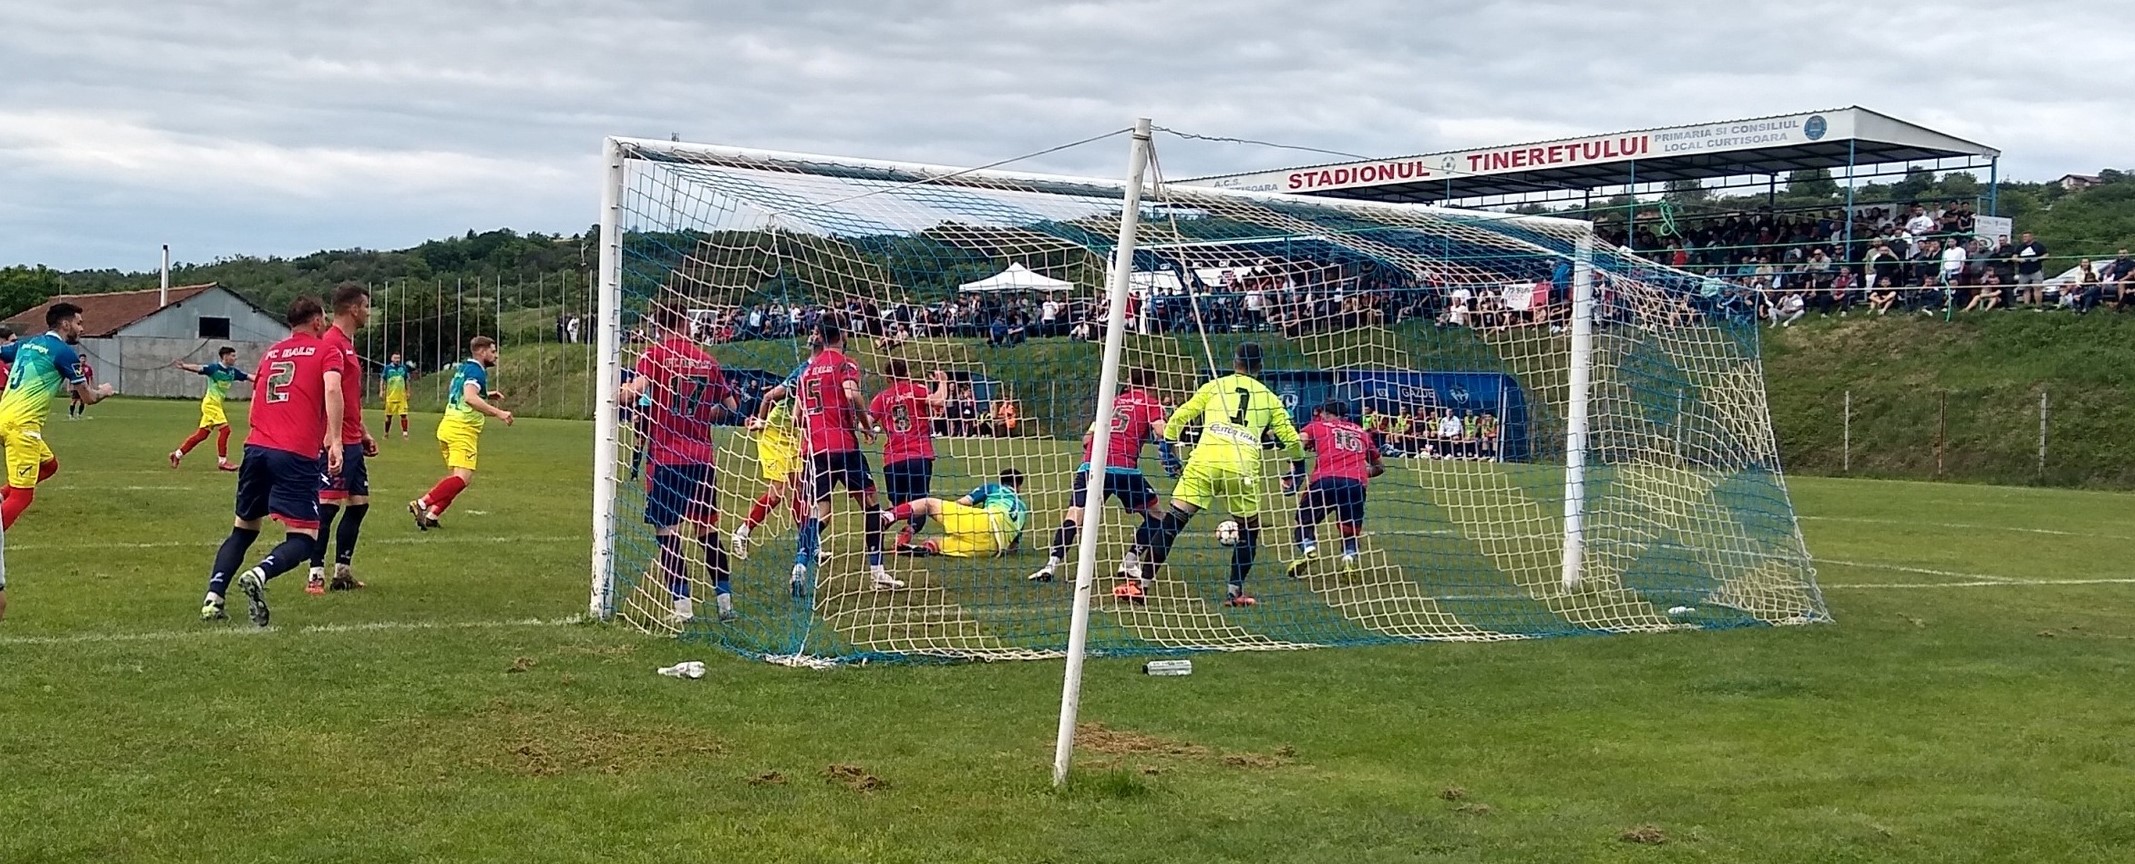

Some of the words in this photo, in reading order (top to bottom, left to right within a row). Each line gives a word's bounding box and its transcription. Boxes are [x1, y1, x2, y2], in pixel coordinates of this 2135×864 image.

[1654, 130, 1712, 142] PRIMARIA
[1715, 127, 1728, 136] SI
[1731, 120, 1800, 134] CONSILIUL
[1664, 141, 1703, 152] LOCAL
[1707, 132, 1788, 148] CURTISOARA
[1288, 160, 1431, 190] STADIONUL
[1467, 135, 1649, 172] TINERETULUI
[266, 360, 296, 404] 2
[669, 373, 710, 418] 17
[806, 377, 824, 416] 5
[891, 403, 912, 433] 8
[1110, 404, 1135, 433] 5
[1229, 386, 1250, 428] 1
[1331, 427, 1363, 453] 16
